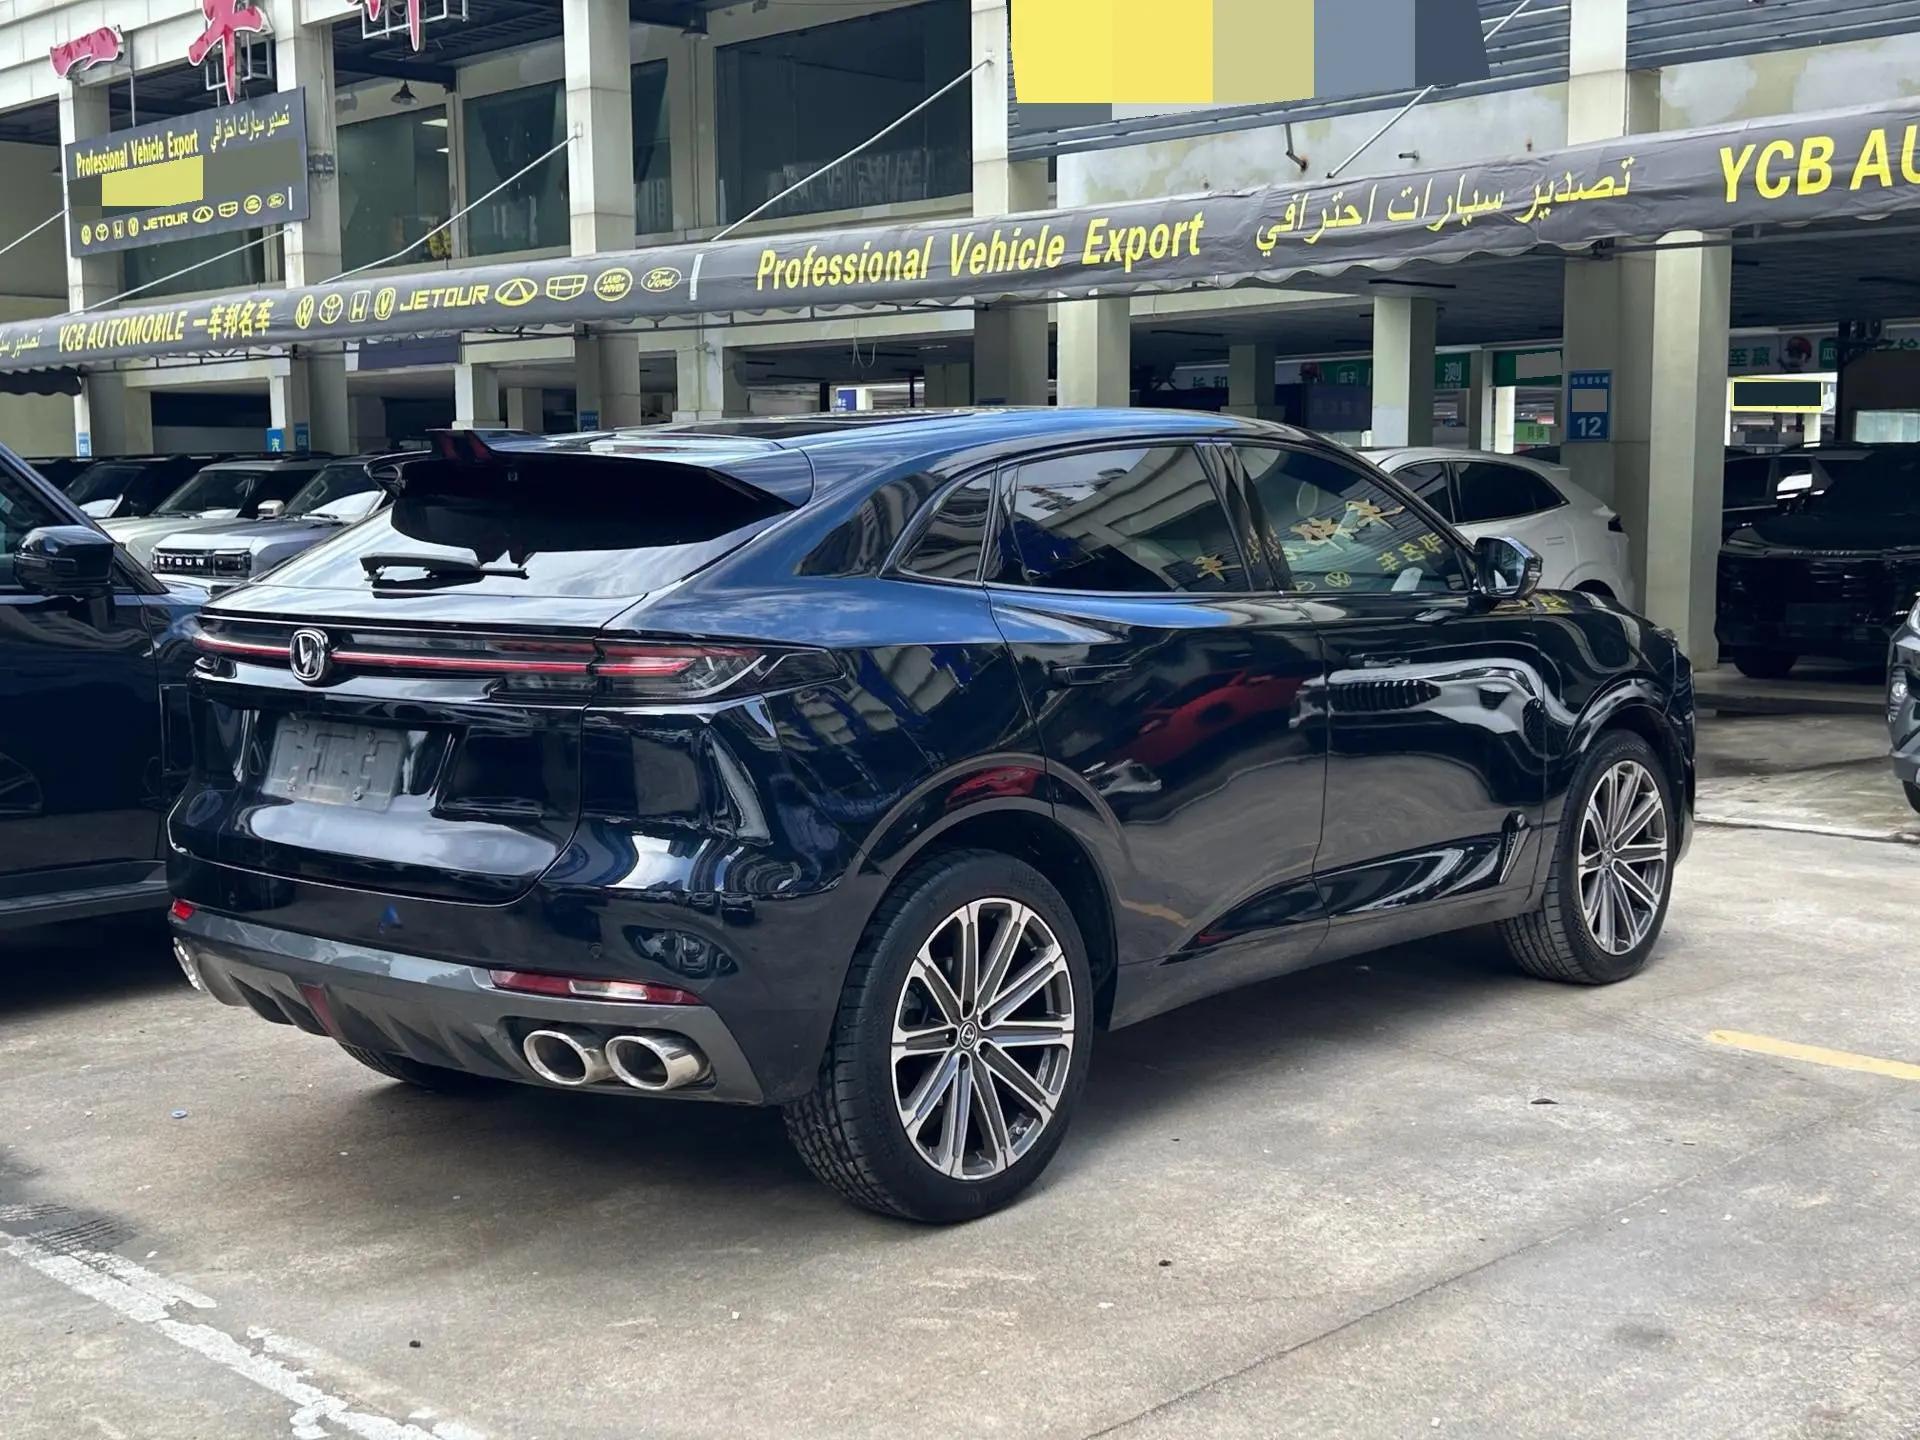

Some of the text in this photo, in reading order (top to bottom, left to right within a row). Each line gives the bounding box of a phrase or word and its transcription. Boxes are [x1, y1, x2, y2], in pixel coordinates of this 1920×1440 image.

[76, 129, 199, 178] Professional Vehicle Export
[1719, 136, 1835, 203] YCB
[143, 212, 189, 231] JETOUR
[1256, 156, 1635, 257] تصدير سيارات احترافي
[756, 211, 1206, 290] Professional Vehicle Export
[399, 285, 490, 312] JETOUR
[647, 270, 676, 288] Ford
[59, 310, 188, 352] YCB AUTOMOBILE
[192, 299, 275, 341] 一车邦名车
[1577, 416, 1602, 437] 12
